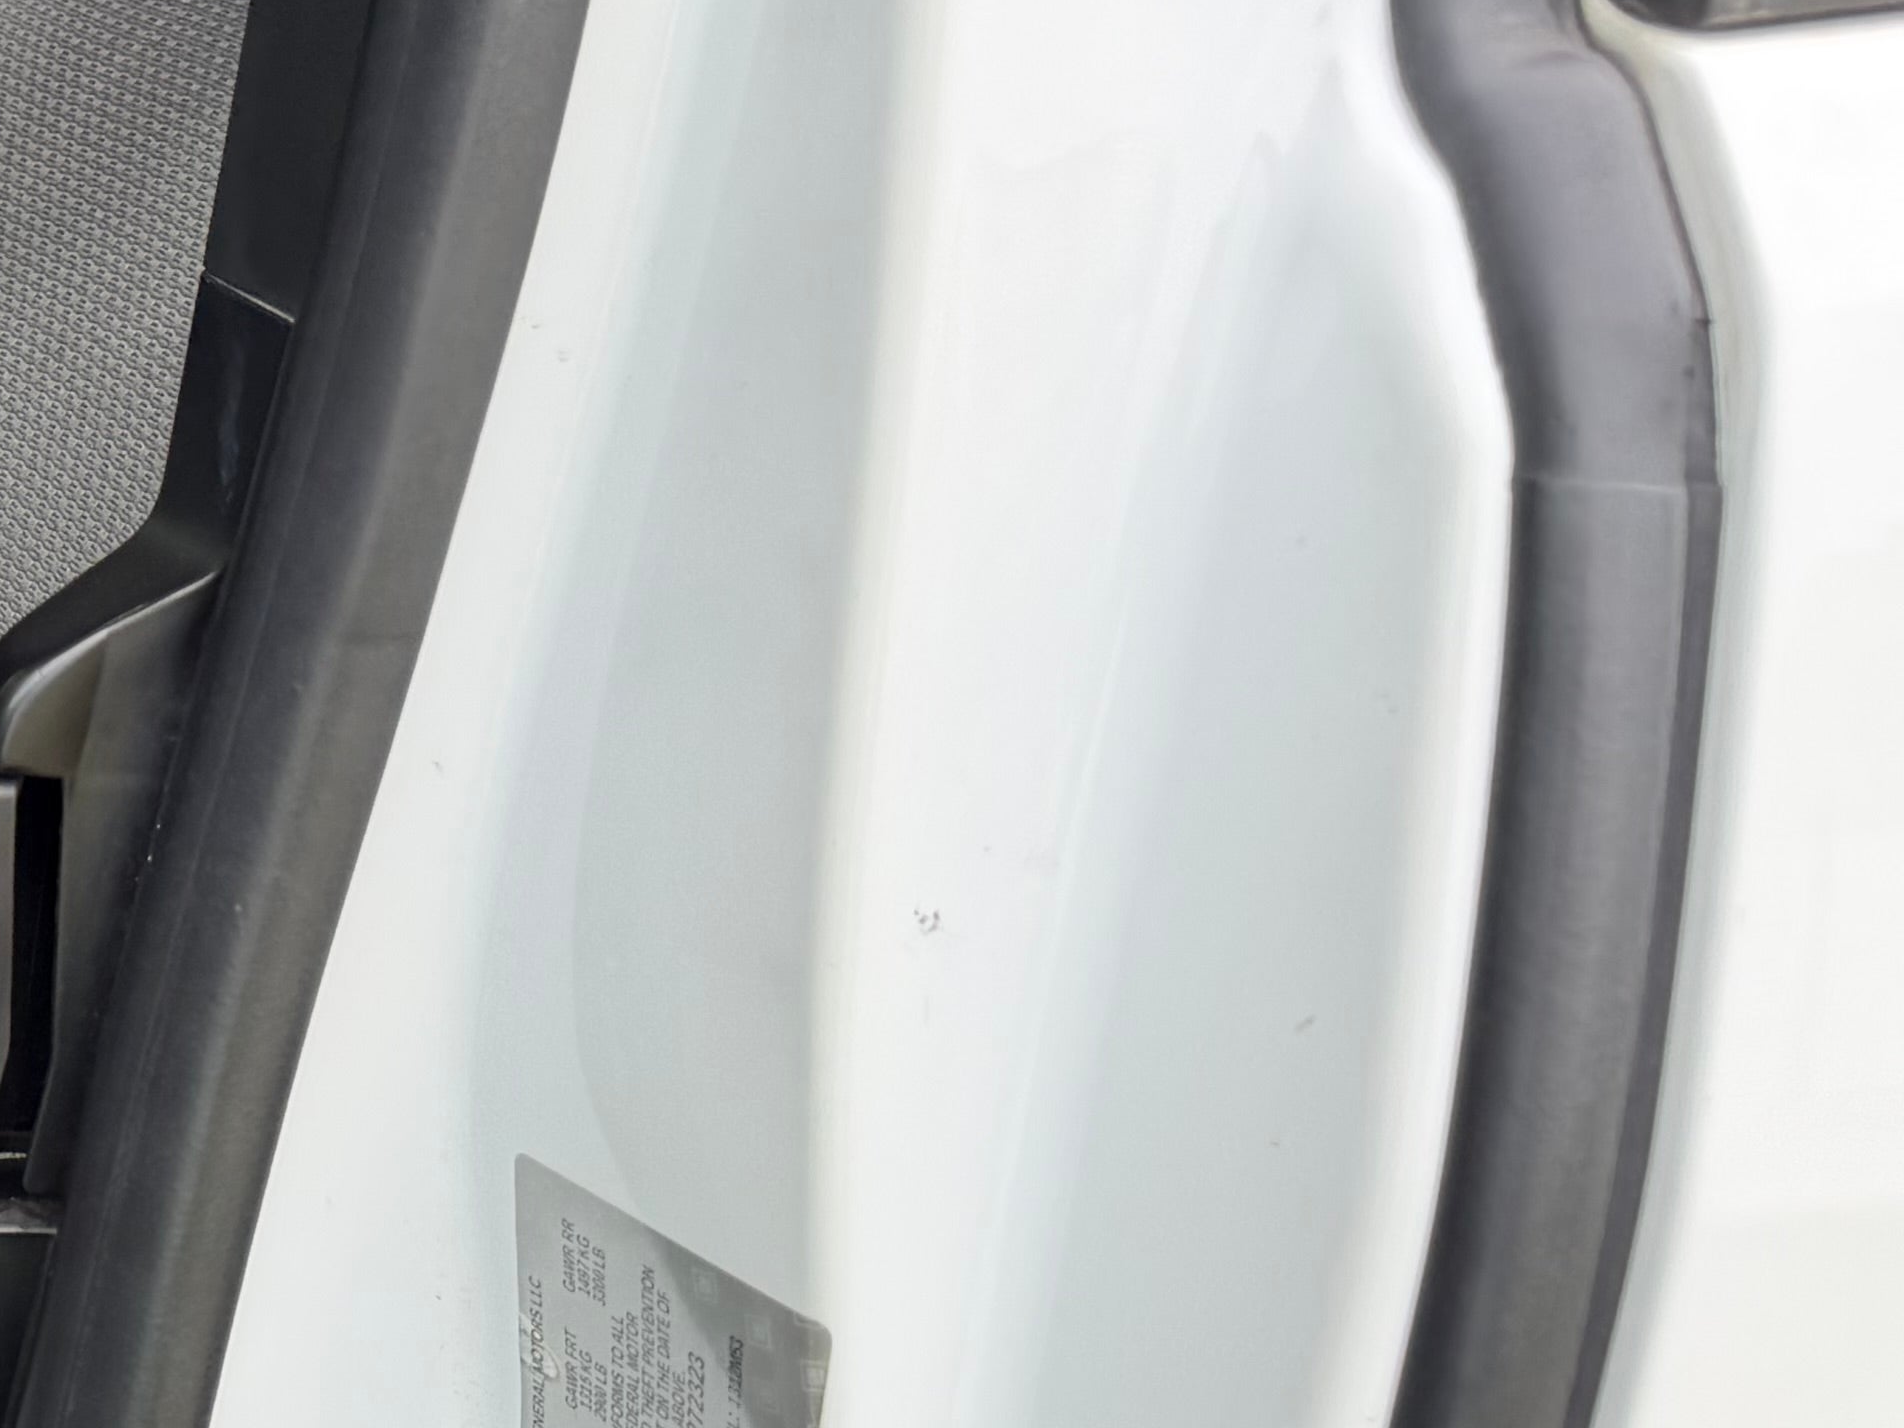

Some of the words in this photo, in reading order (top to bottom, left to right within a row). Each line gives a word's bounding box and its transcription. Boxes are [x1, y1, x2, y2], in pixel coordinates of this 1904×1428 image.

[562, 1218, 575, 1243] RR
[577, 1234, 589, 1260] KG
[562, 1244, 575, 1293] GAWR
[529, 1275, 541, 1308] LLC
[656, 1290, 670, 1315] OF
[611, 1316, 624, 1346] ALL
[641, 1264, 655, 1367] PREVENTION
[626, 1311, 639, 1372] MOTOR
[656, 1315, 670, 1360] DATE
[611, 1346, 623, 1369] TO
[656, 1360, 669, 1392] THE
[640, 1366, 655, 1419] THEFT
[656, 1394, 669, 1421] ON
